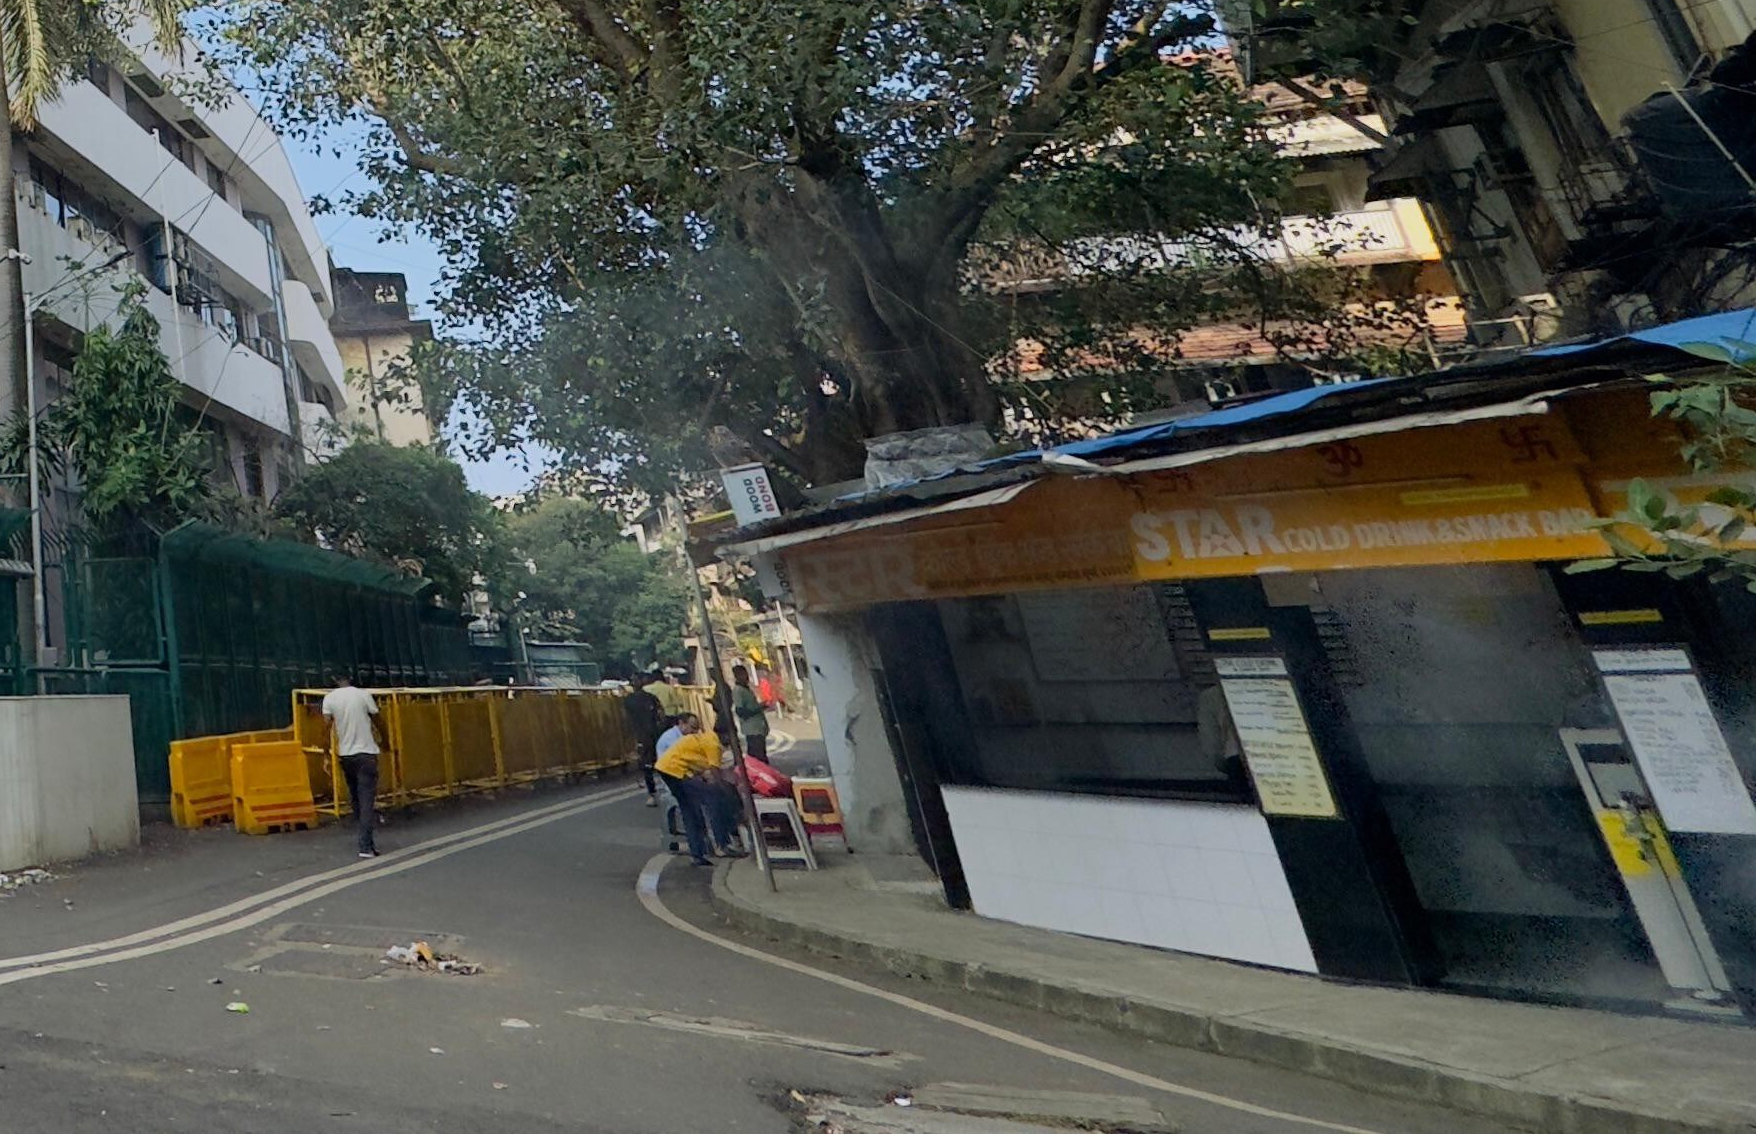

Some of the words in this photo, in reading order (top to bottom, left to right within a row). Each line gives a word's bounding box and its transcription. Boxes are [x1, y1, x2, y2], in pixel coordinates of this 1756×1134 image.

[743, 478, 763, 514] WOOD
[755, 476, 775, 512] BOND
[1130, 504, 1287, 561] STAR
[1283, 524, 1350, 553] COLD
